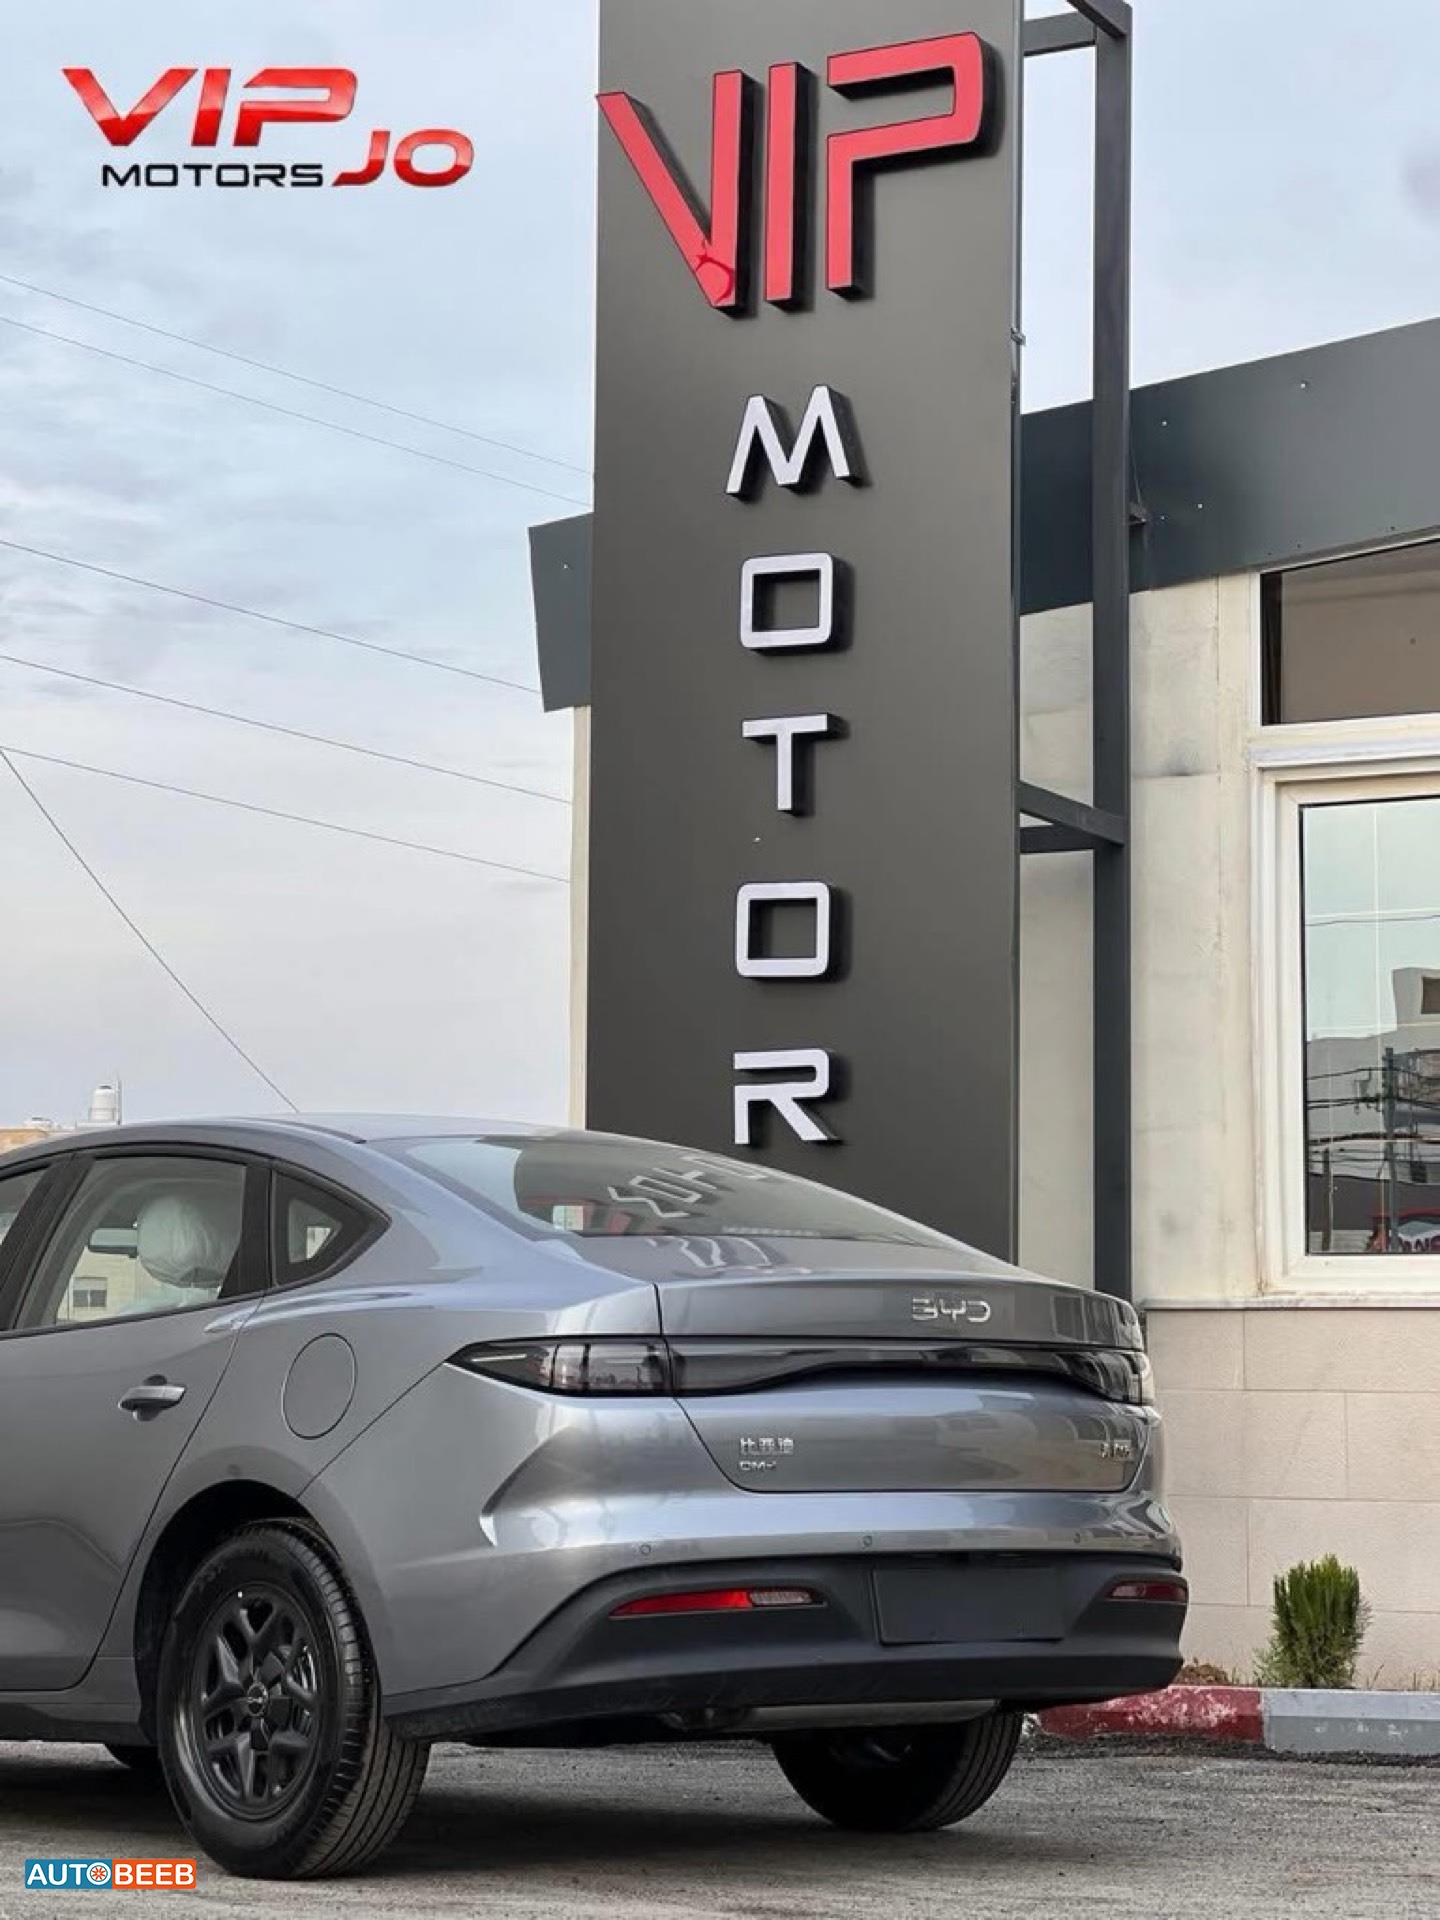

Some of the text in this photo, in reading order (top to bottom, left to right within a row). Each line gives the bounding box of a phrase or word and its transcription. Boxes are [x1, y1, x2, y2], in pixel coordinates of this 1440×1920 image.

[595, 32, 984, 308] VIP
[726, 384, 851, 1145] MOTOR
[912, 1298, 991, 1323] BYD
